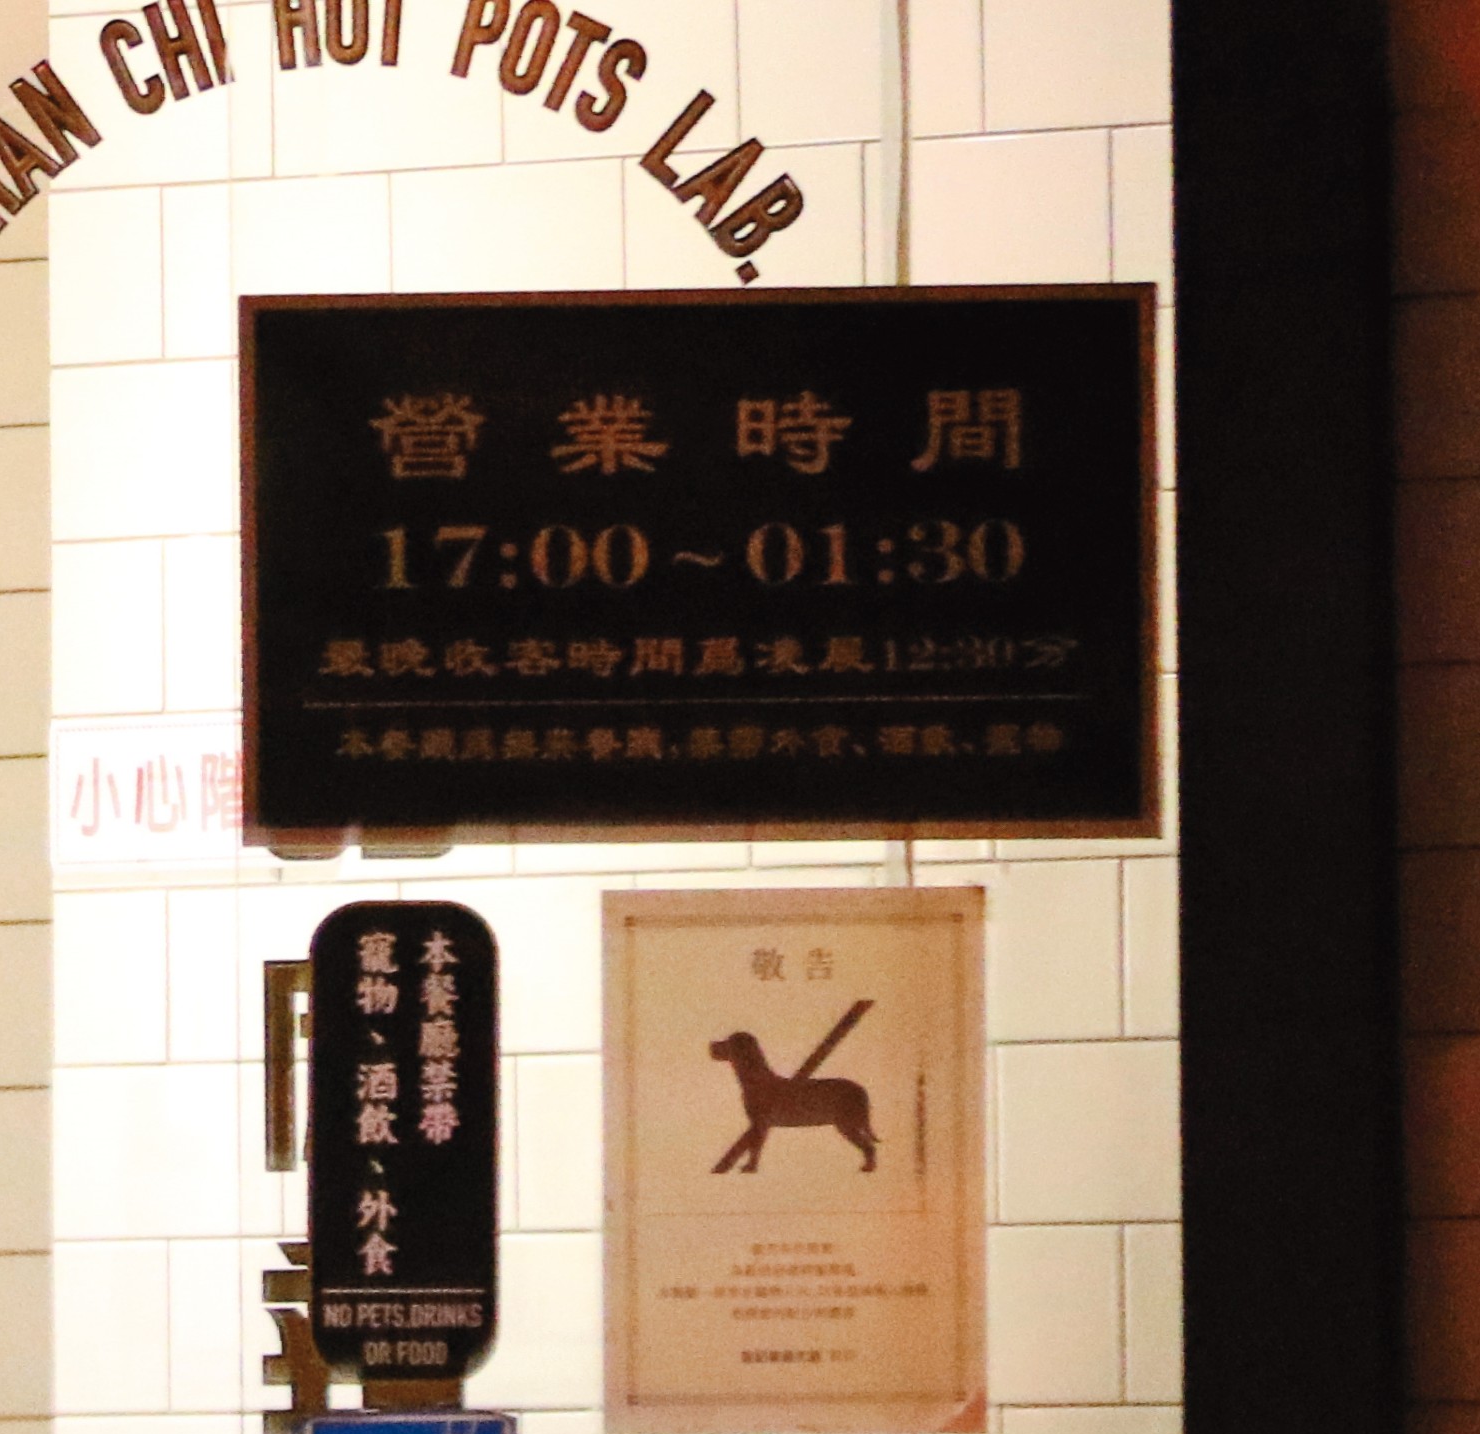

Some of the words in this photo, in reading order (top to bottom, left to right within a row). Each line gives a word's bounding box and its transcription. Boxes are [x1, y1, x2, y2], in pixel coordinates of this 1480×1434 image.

[98, 0, 236, 116] CHI
[276, 0, 406, 71] HOT
[449, 0, 647, 133] POTS
[638, 88, 804, 285] LAB.
[370, 387, 1026, 481] 營業時間
[750, 948, 834, 981] 敬告
[419, 931, 460, 1145] 本餐廳禁帶
[356, 931, 399, 1276] 寵物、酒飲、外食
[323, 1303, 352, 1328] NO
[364, 1341, 391, 1365] OR
[397, 1341, 449, 1365] FOOD
